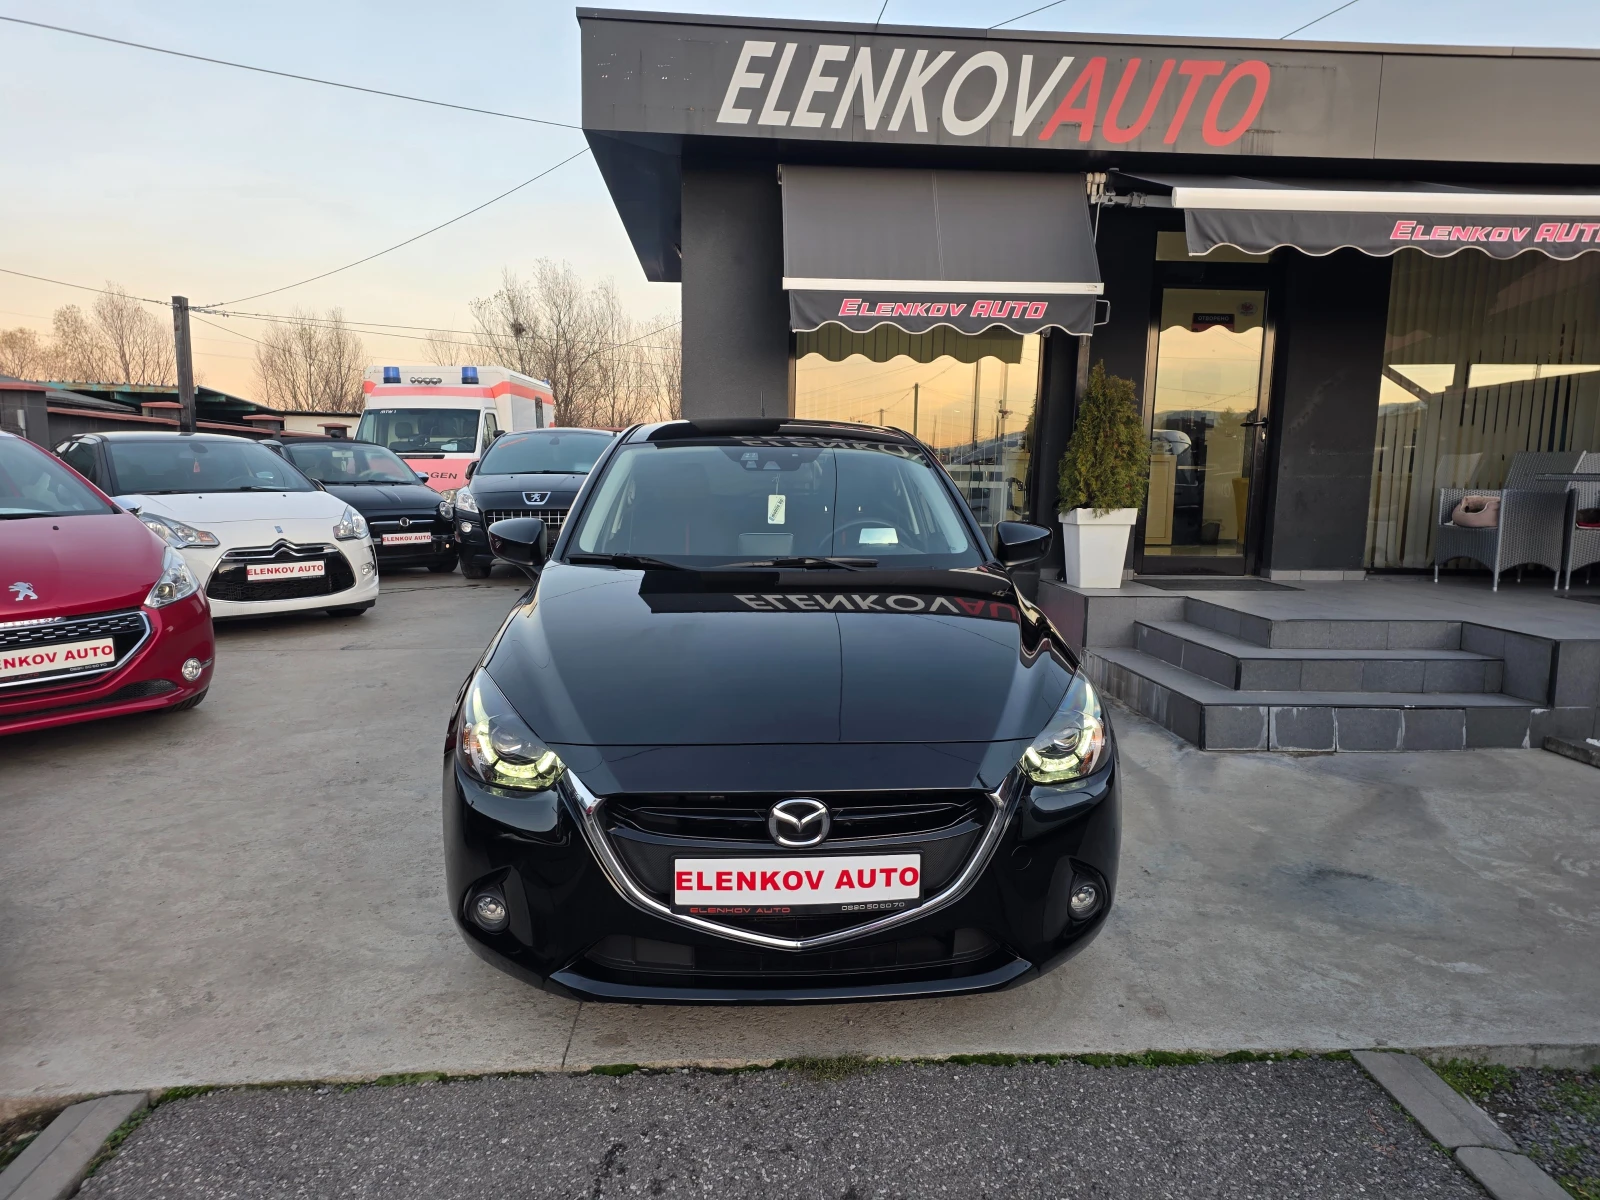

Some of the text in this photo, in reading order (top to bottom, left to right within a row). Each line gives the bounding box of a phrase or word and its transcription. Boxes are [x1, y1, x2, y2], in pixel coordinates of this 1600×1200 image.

[1533, 222, 1600, 243] AUT
[838, 298, 1049, 319] ELENKOV AUTO
[425, 471, 458, 480] GEN
[247, 564, 324, 576] ELENKOV AUTO
[0, 656, 57, 670] NKOV
[64, 645, 113, 661] AUTO
[675, 866, 919, 891] ELENKOV AUTO
